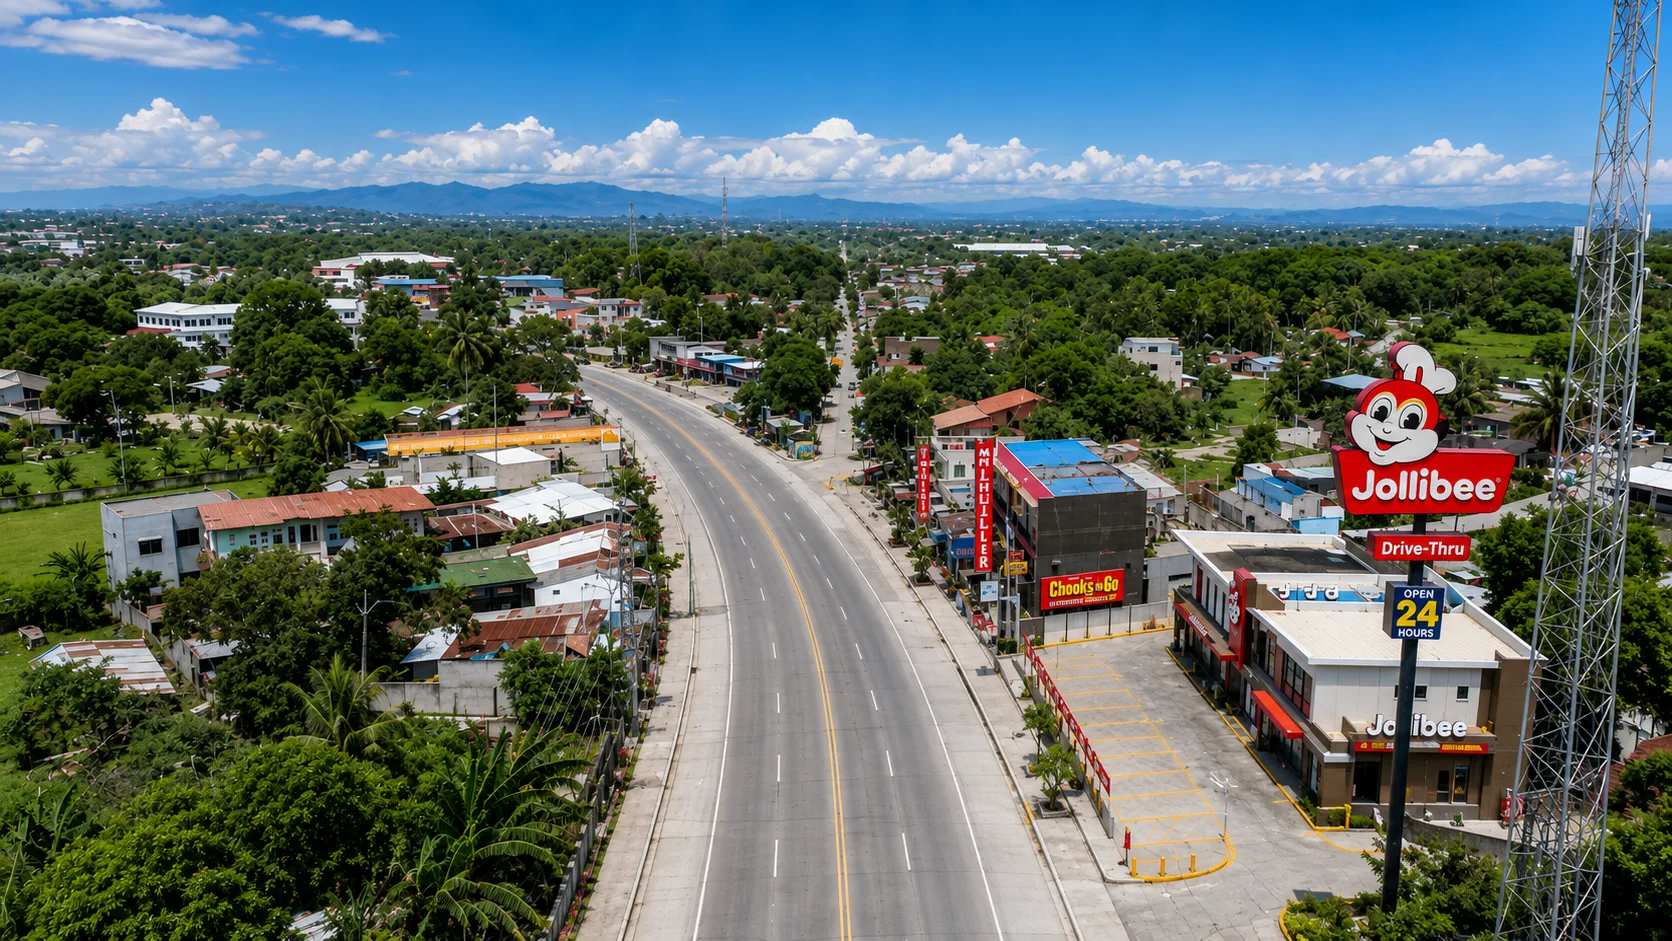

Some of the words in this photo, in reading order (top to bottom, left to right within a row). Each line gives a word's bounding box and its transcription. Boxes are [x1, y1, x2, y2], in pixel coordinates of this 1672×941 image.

[1352, 468, 1496, 501] Jollibee
[1381, 541, 1465, 556] Drive-Thru
[1049, 579, 1094, 598] Chooks
[1104, 575, 1119, 592] Go
[1404, 589, 1434, 599] OPEN
[1396, 599, 1439, 628] 24
[1398, 628, 1434, 638] HOURS
[1366, 713, 1467, 738] Joibee
